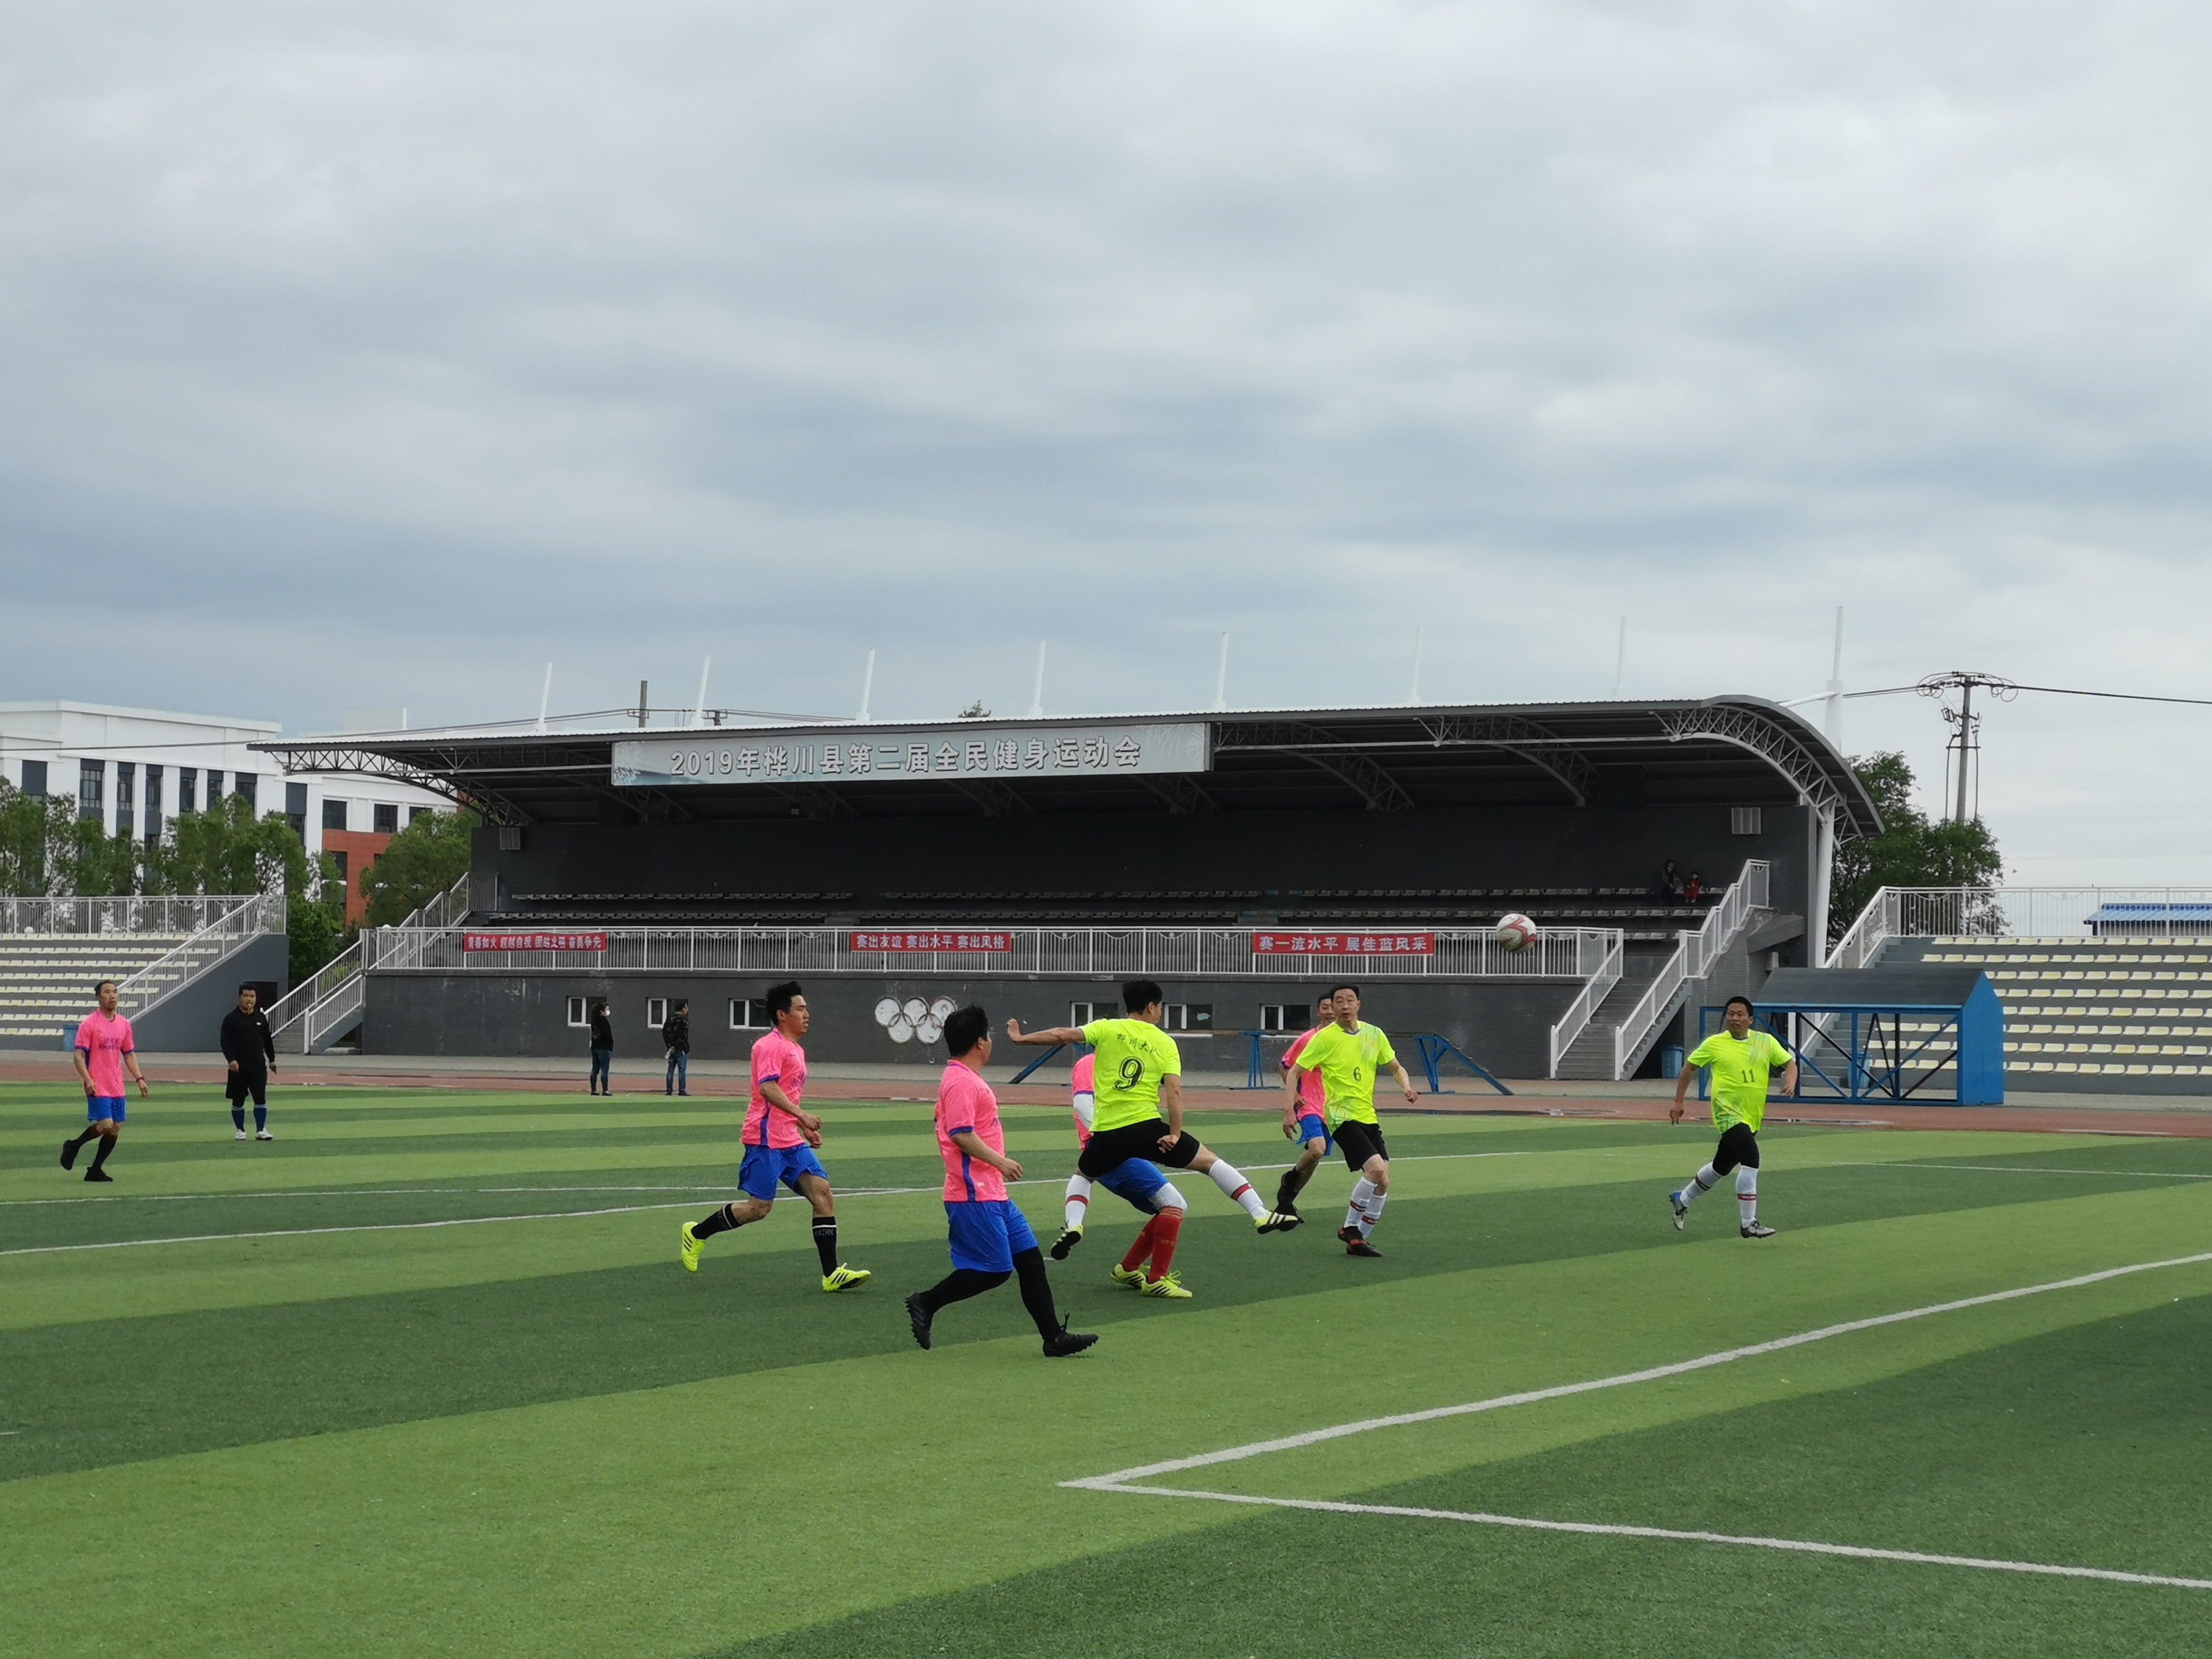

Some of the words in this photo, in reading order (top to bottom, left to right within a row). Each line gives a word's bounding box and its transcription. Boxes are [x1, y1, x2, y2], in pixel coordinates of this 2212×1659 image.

[670, 735, 1141, 776] 2019年桦川县第二届全民健身运动会
[857, 934, 902, 948] 赛出友谊
[907, 934, 953, 948] 赛出水平
[958, 934, 1005, 949] 赛出风格
[1259, 935, 1338, 951] 赛一流水平
[1113, 1056, 1145, 1092] 9
[1353, 1066, 1362, 1082] 6
[1740, 1069, 1756, 1084] 11
